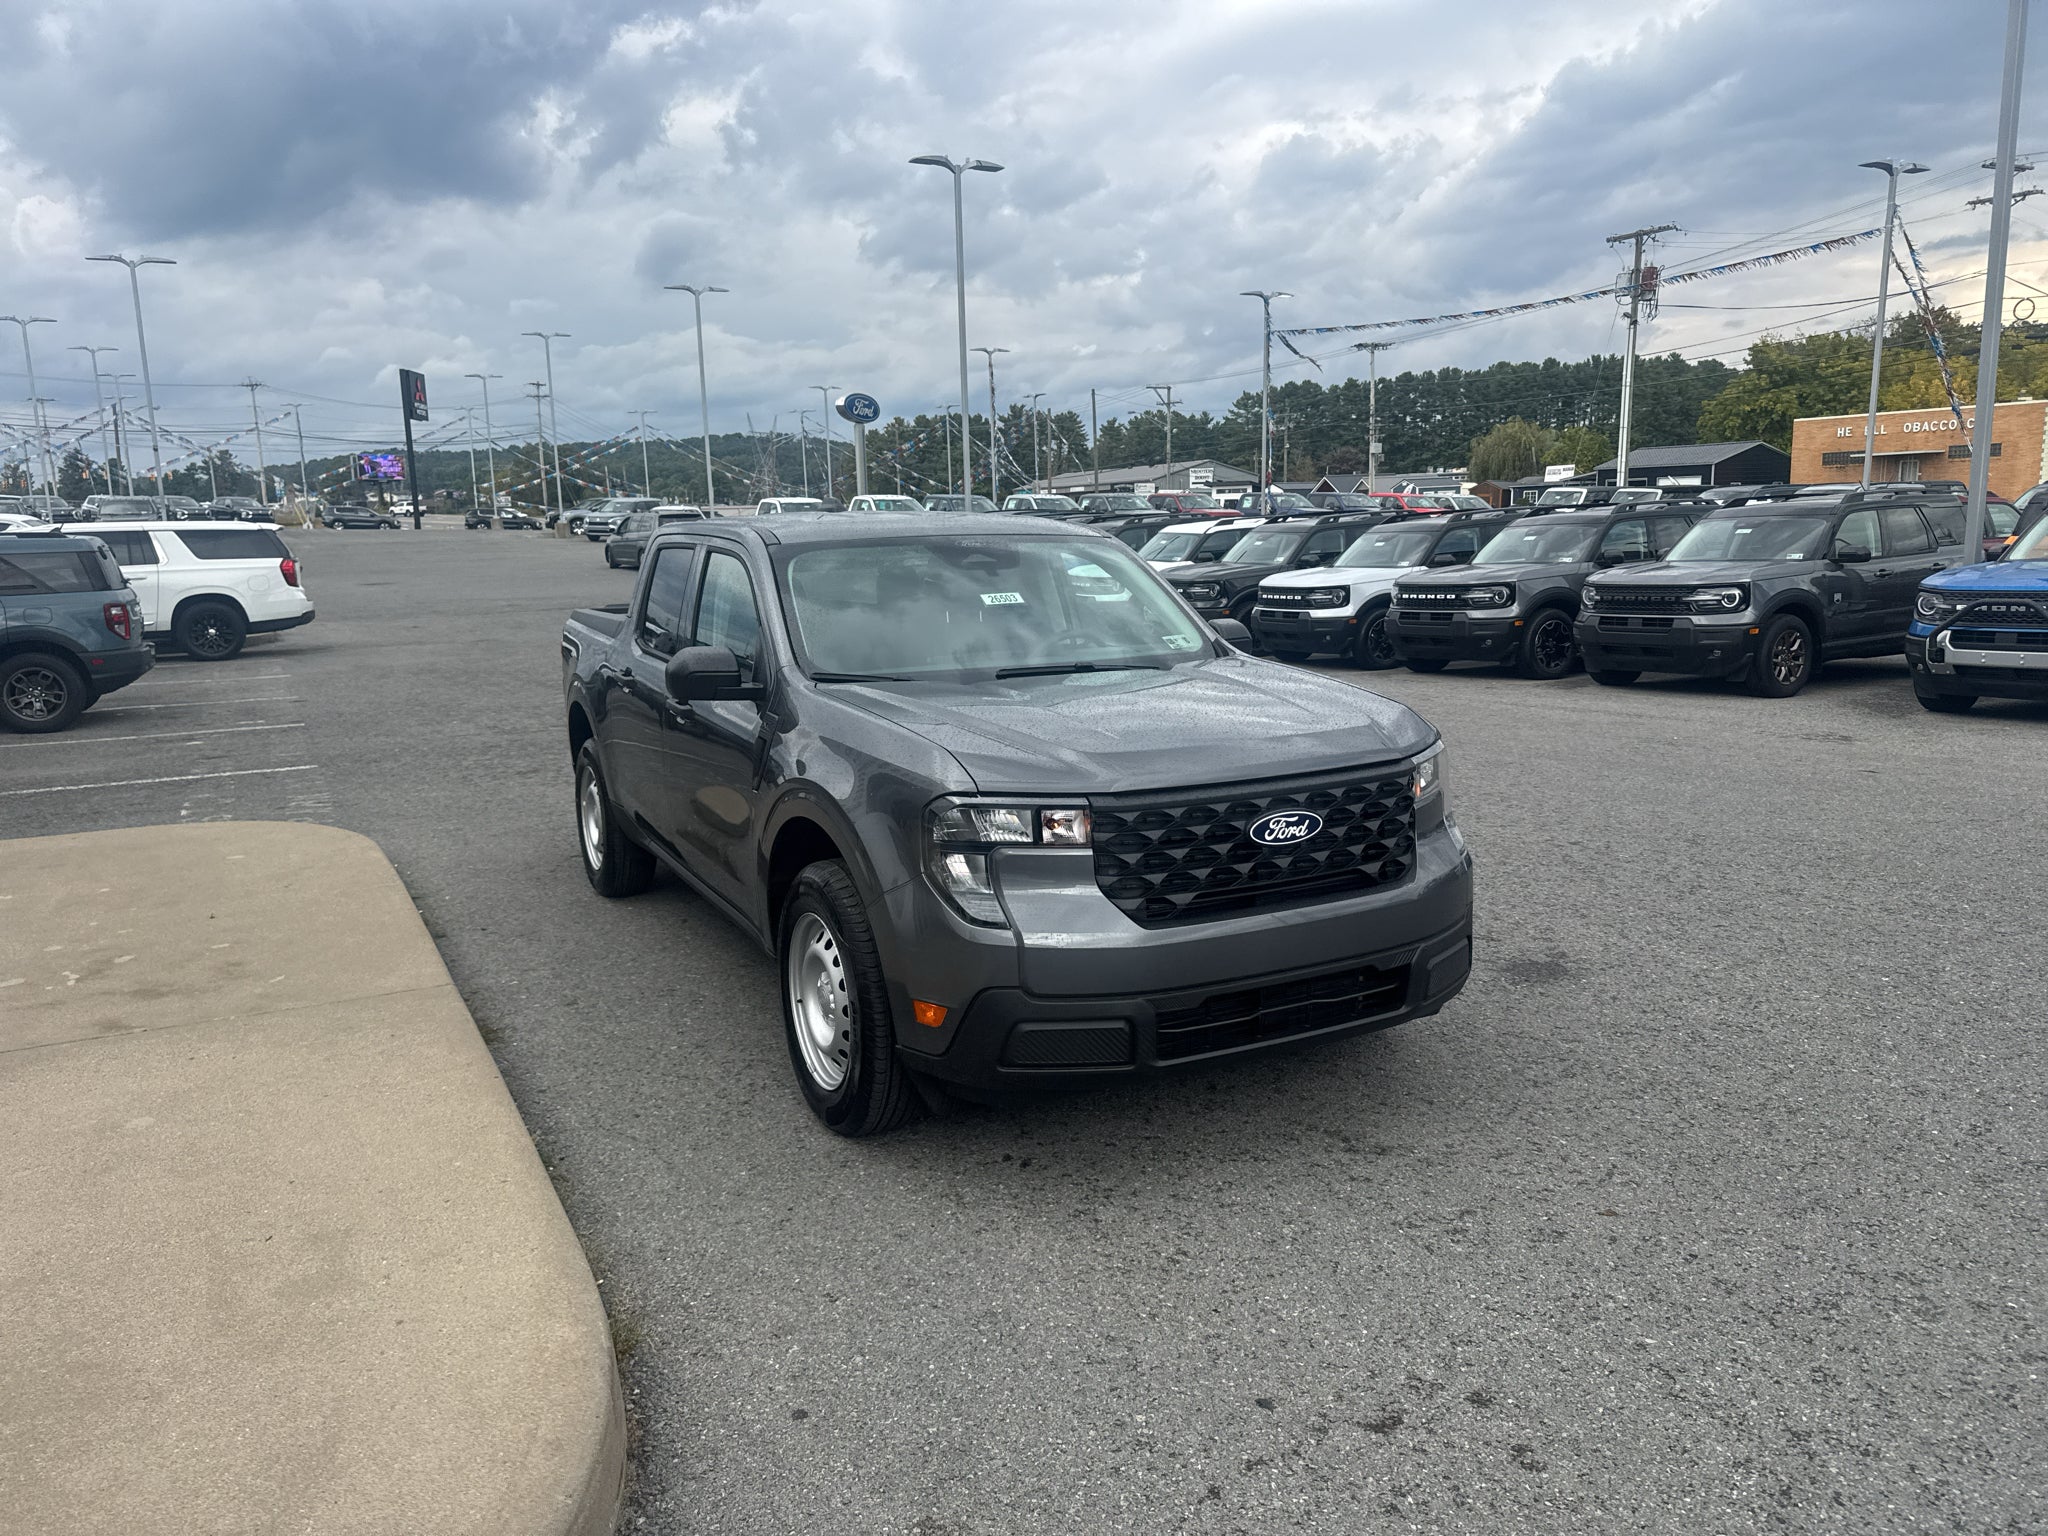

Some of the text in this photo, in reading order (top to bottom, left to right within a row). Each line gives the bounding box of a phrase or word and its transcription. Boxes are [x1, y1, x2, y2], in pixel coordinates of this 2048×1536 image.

[852, 398, 875, 418] Ford
[1903, 419, 1958, 433] OBACCO
[988, 594, 1018, 604] 26503
[1264, 816, 1310, 841] Ford
